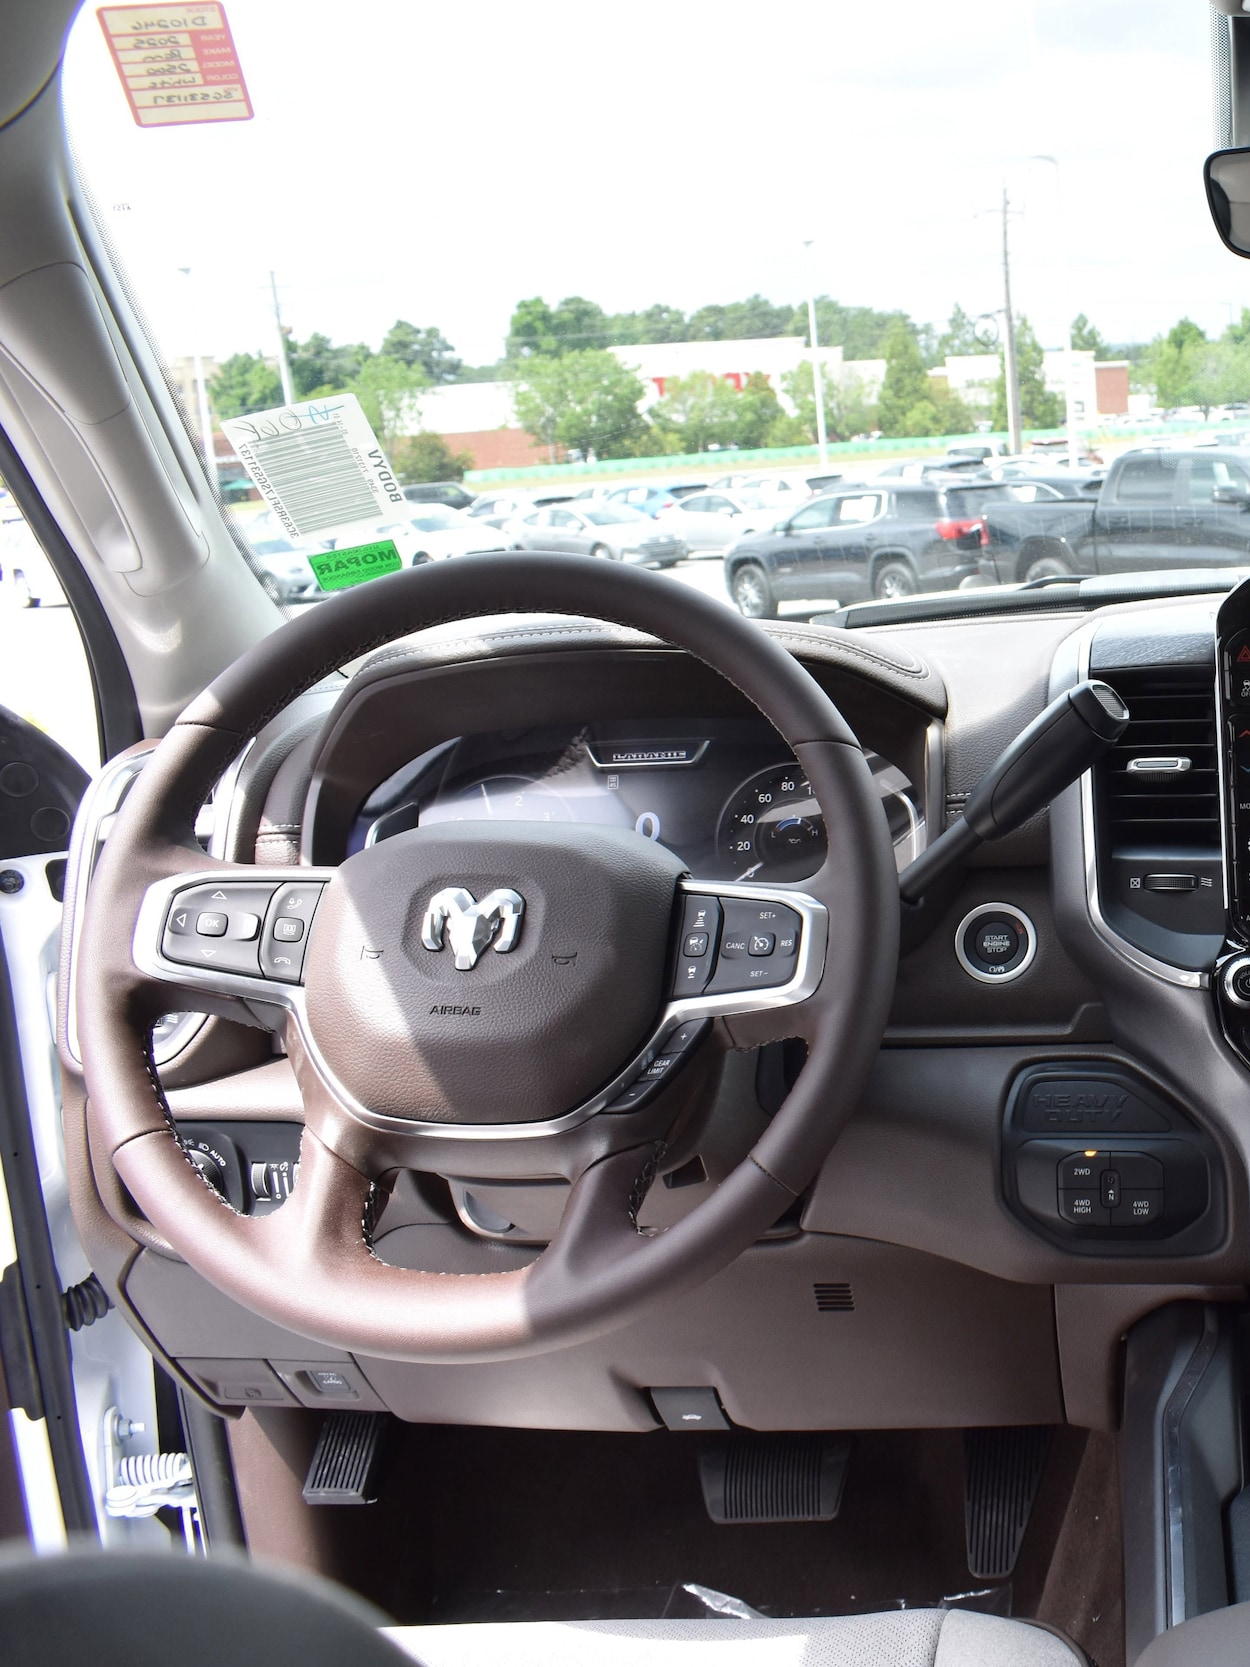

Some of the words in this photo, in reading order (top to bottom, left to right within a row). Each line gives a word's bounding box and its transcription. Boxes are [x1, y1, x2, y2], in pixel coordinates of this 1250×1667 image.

[613, 751, 687, 761] LARAMIE
[781, 781, 795, 791] 80
[515, 795, 523, 806] 2
[758, 793, 772, 803] 60
[740, 814, 755, 824] 40
[737, 841, 751, 851] 20
[205, 919, 219, 928] OK
[725, 942, 746, 950] CANC
[780, 939, 793, 948] RES
[429, 1005, 481, 1016] AIRBAG
[647, 1067, 665, 1075] LIMIT
[1032, 1094, 1130, 1108] HEAVY
[1044, 1109, 1122, 1123] DUTY
[210, 1150, 226, 1167] AUTO
[1073, 1168, 1091, 1176] 2WD
